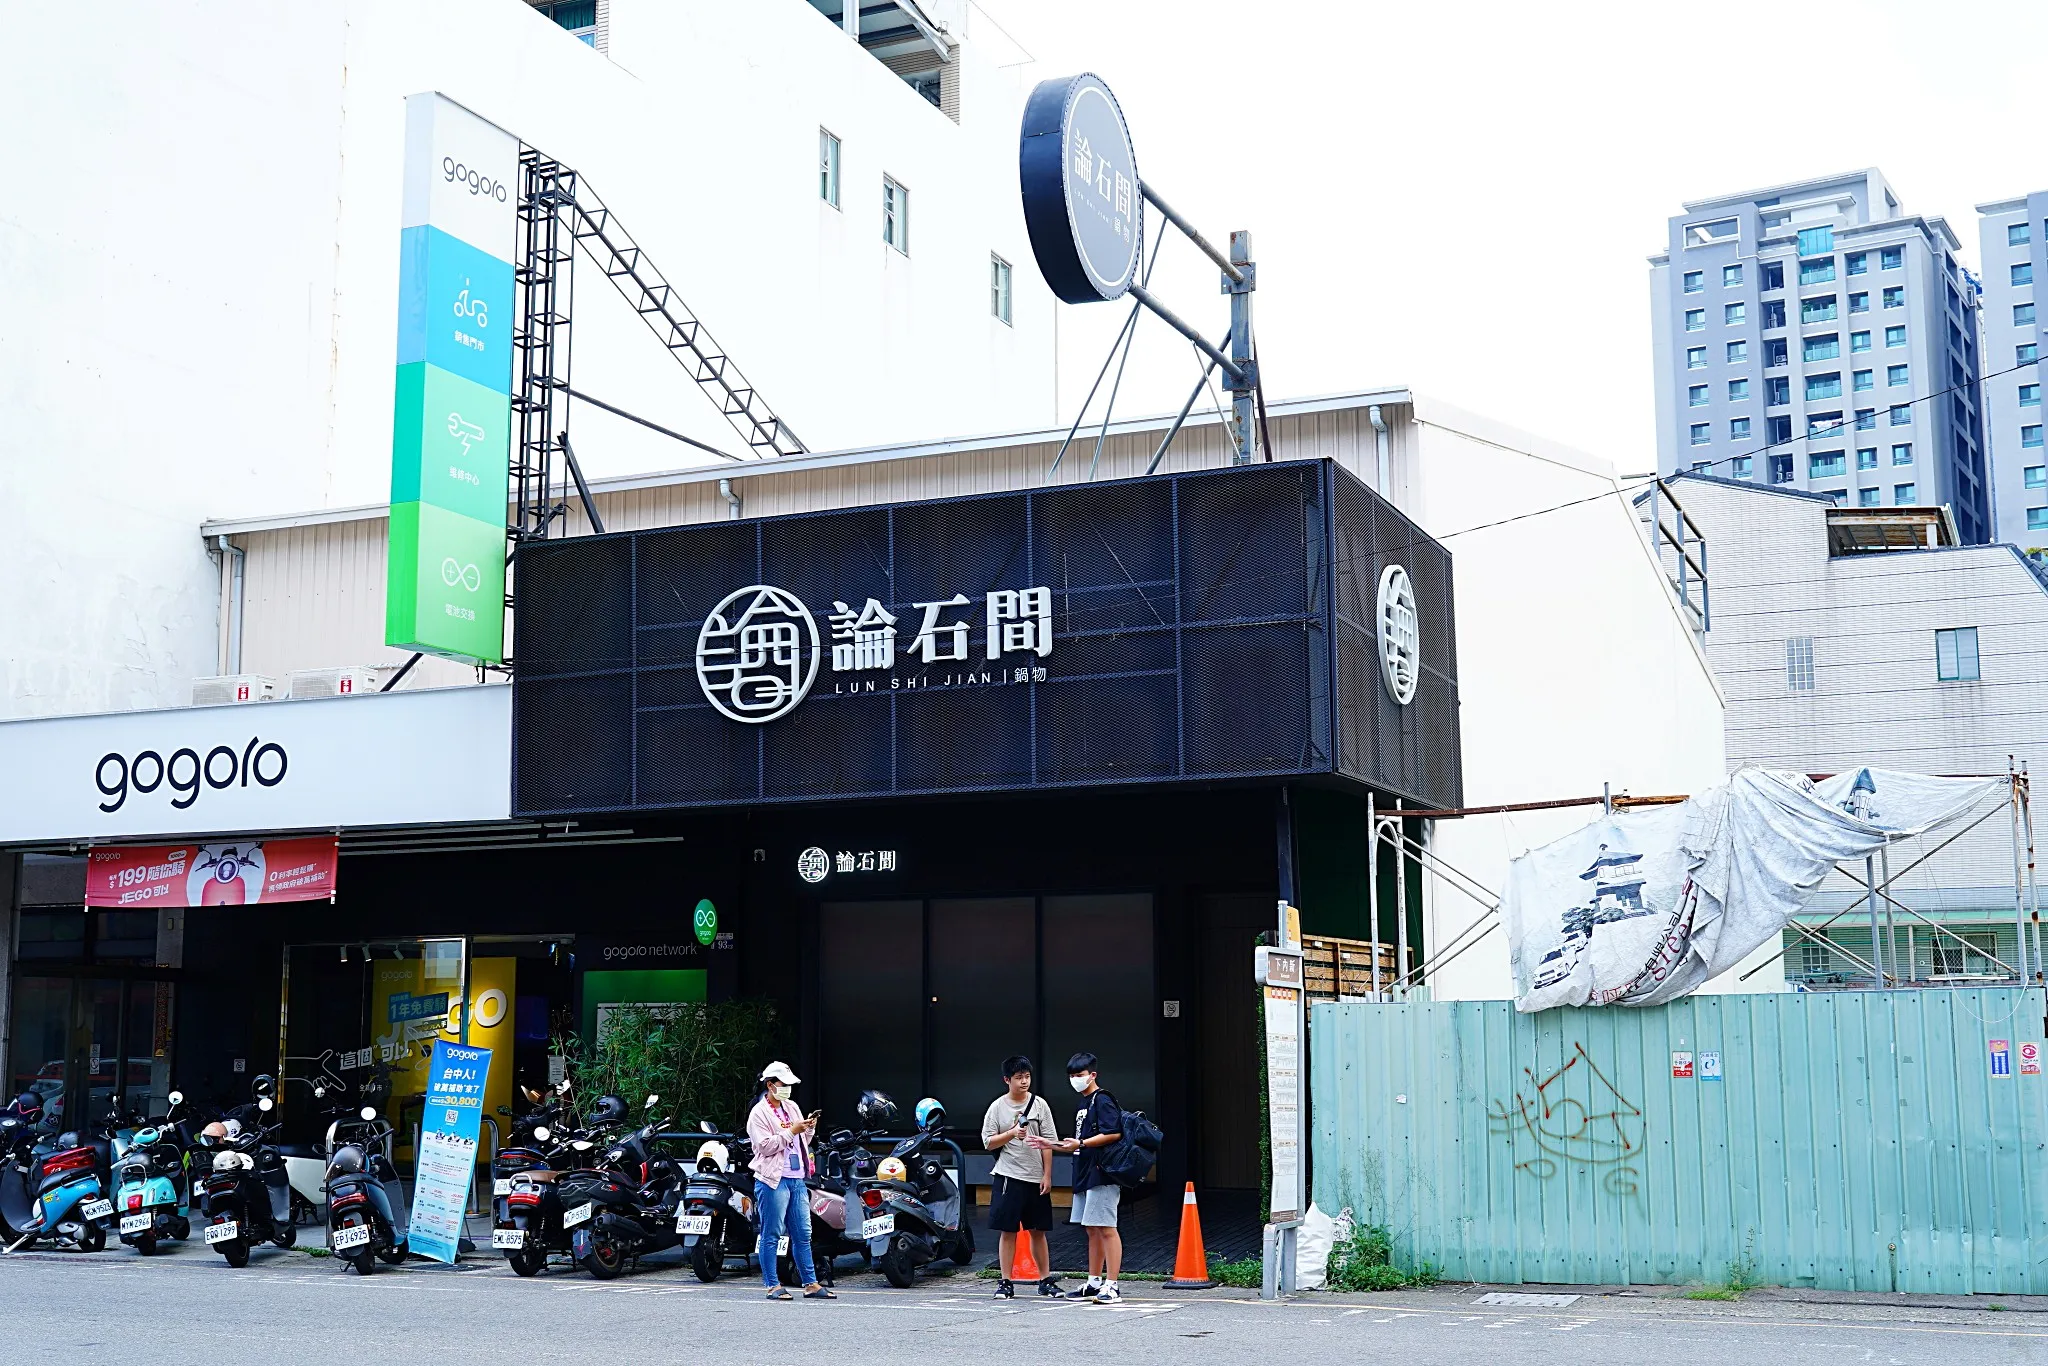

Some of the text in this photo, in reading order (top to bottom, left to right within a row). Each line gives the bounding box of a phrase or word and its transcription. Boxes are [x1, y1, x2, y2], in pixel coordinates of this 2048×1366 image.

[443, 156, 507, 203] gogoro
[1074, 127, 1132, 223] 論石間
[449, 465, 480, 486] 維修中心
[445, 603, 476, 621] 電池交換
[828, 586, 1053, 672] 論石間
[835, 666, 1047, 694] LUN SHI JIAN 鍋物
[94, 736, 288, 813] gogoro
[95, 852, 121, 862] gogoro
[835, 850, 896, 873] 論石間
[117, 883, 169, 905] JEGO 可以
[603, 941, 698, 961] gogoro network
[381, 970, 413, 981] gogoro
[447, 1047, 479, 1061] gogoro
